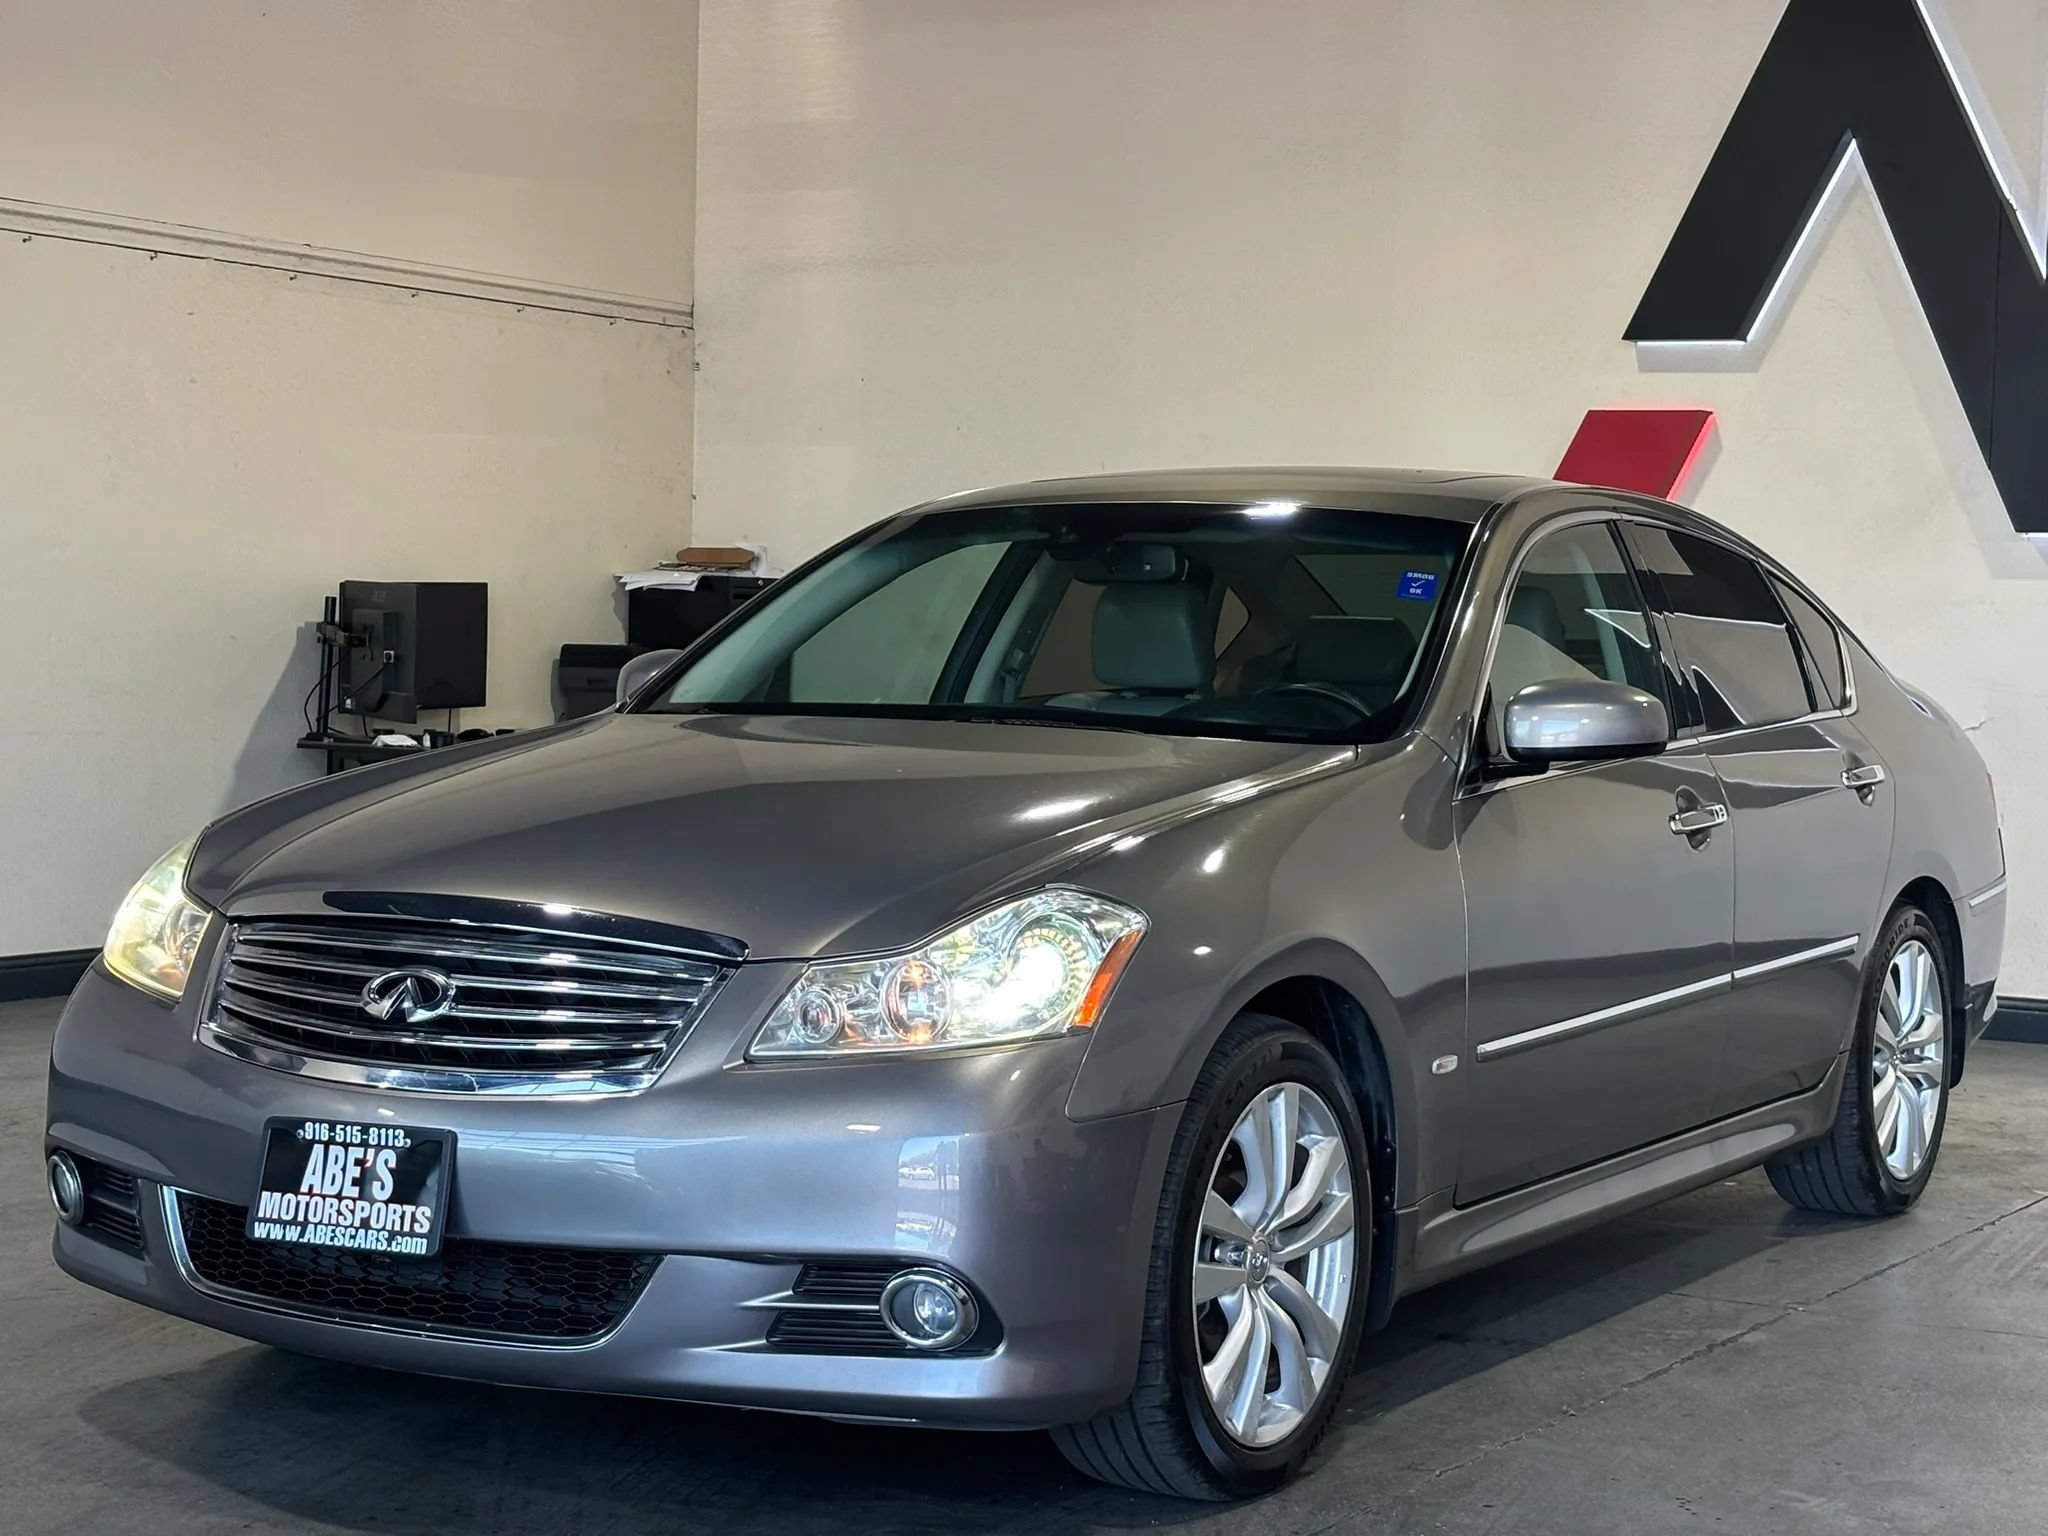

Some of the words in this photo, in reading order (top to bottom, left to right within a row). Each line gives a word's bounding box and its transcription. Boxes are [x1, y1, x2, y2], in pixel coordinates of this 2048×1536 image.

[304, 1121, 405, 1148] 916-515-8113
[300, 1143, 397, 1201] ABE'S
[257, 1191, 432, 1234] MOTORSPORTS
